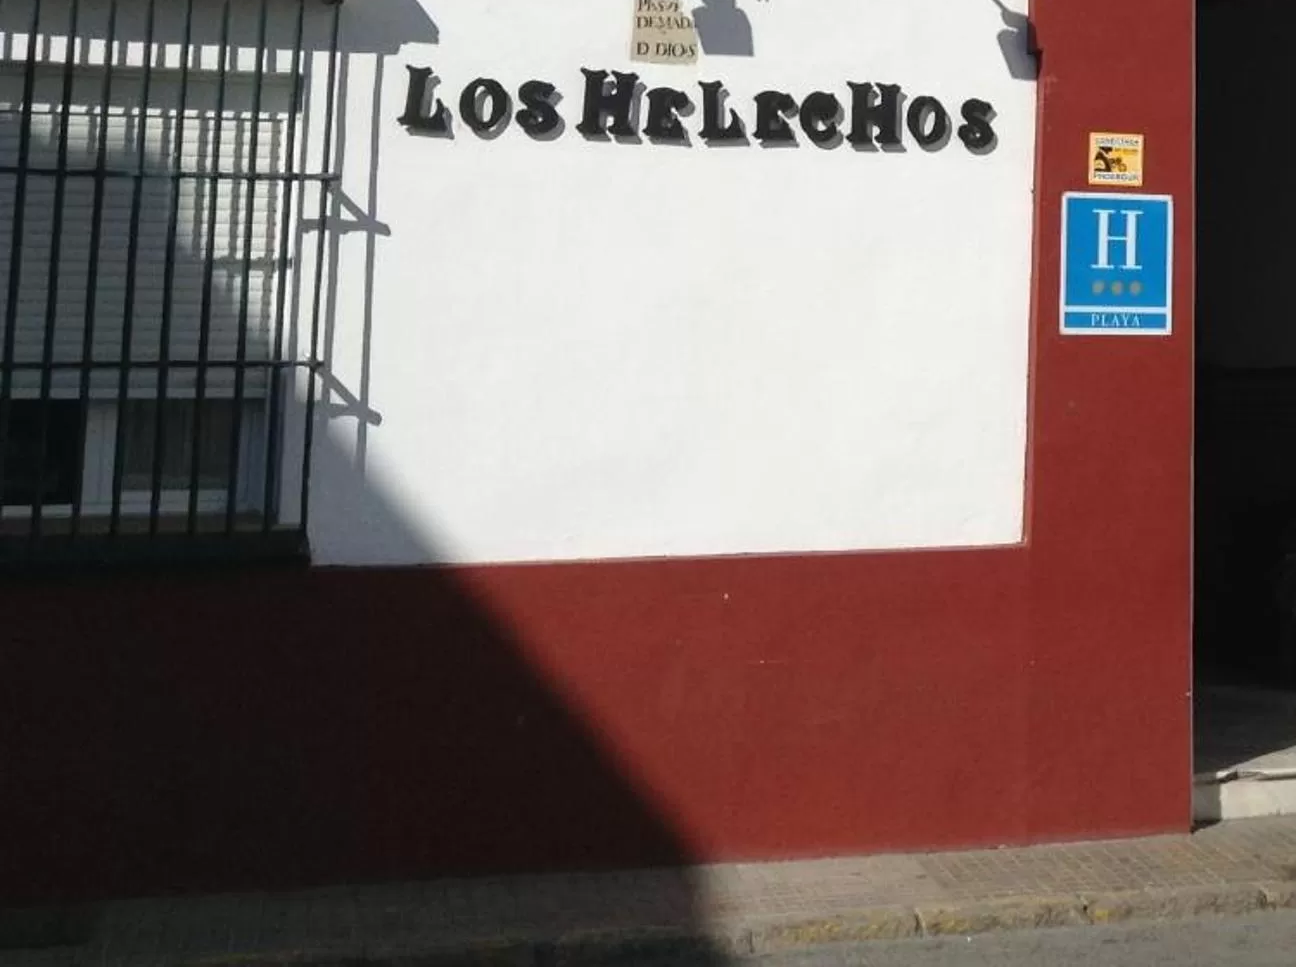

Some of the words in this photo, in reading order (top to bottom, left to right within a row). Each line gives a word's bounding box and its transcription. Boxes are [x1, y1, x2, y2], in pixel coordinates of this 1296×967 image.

[397, 65, 562, 139] LOS
[1091, 208, 1144, 270] H
[1091, 313, 1142, 327] PLAYA
